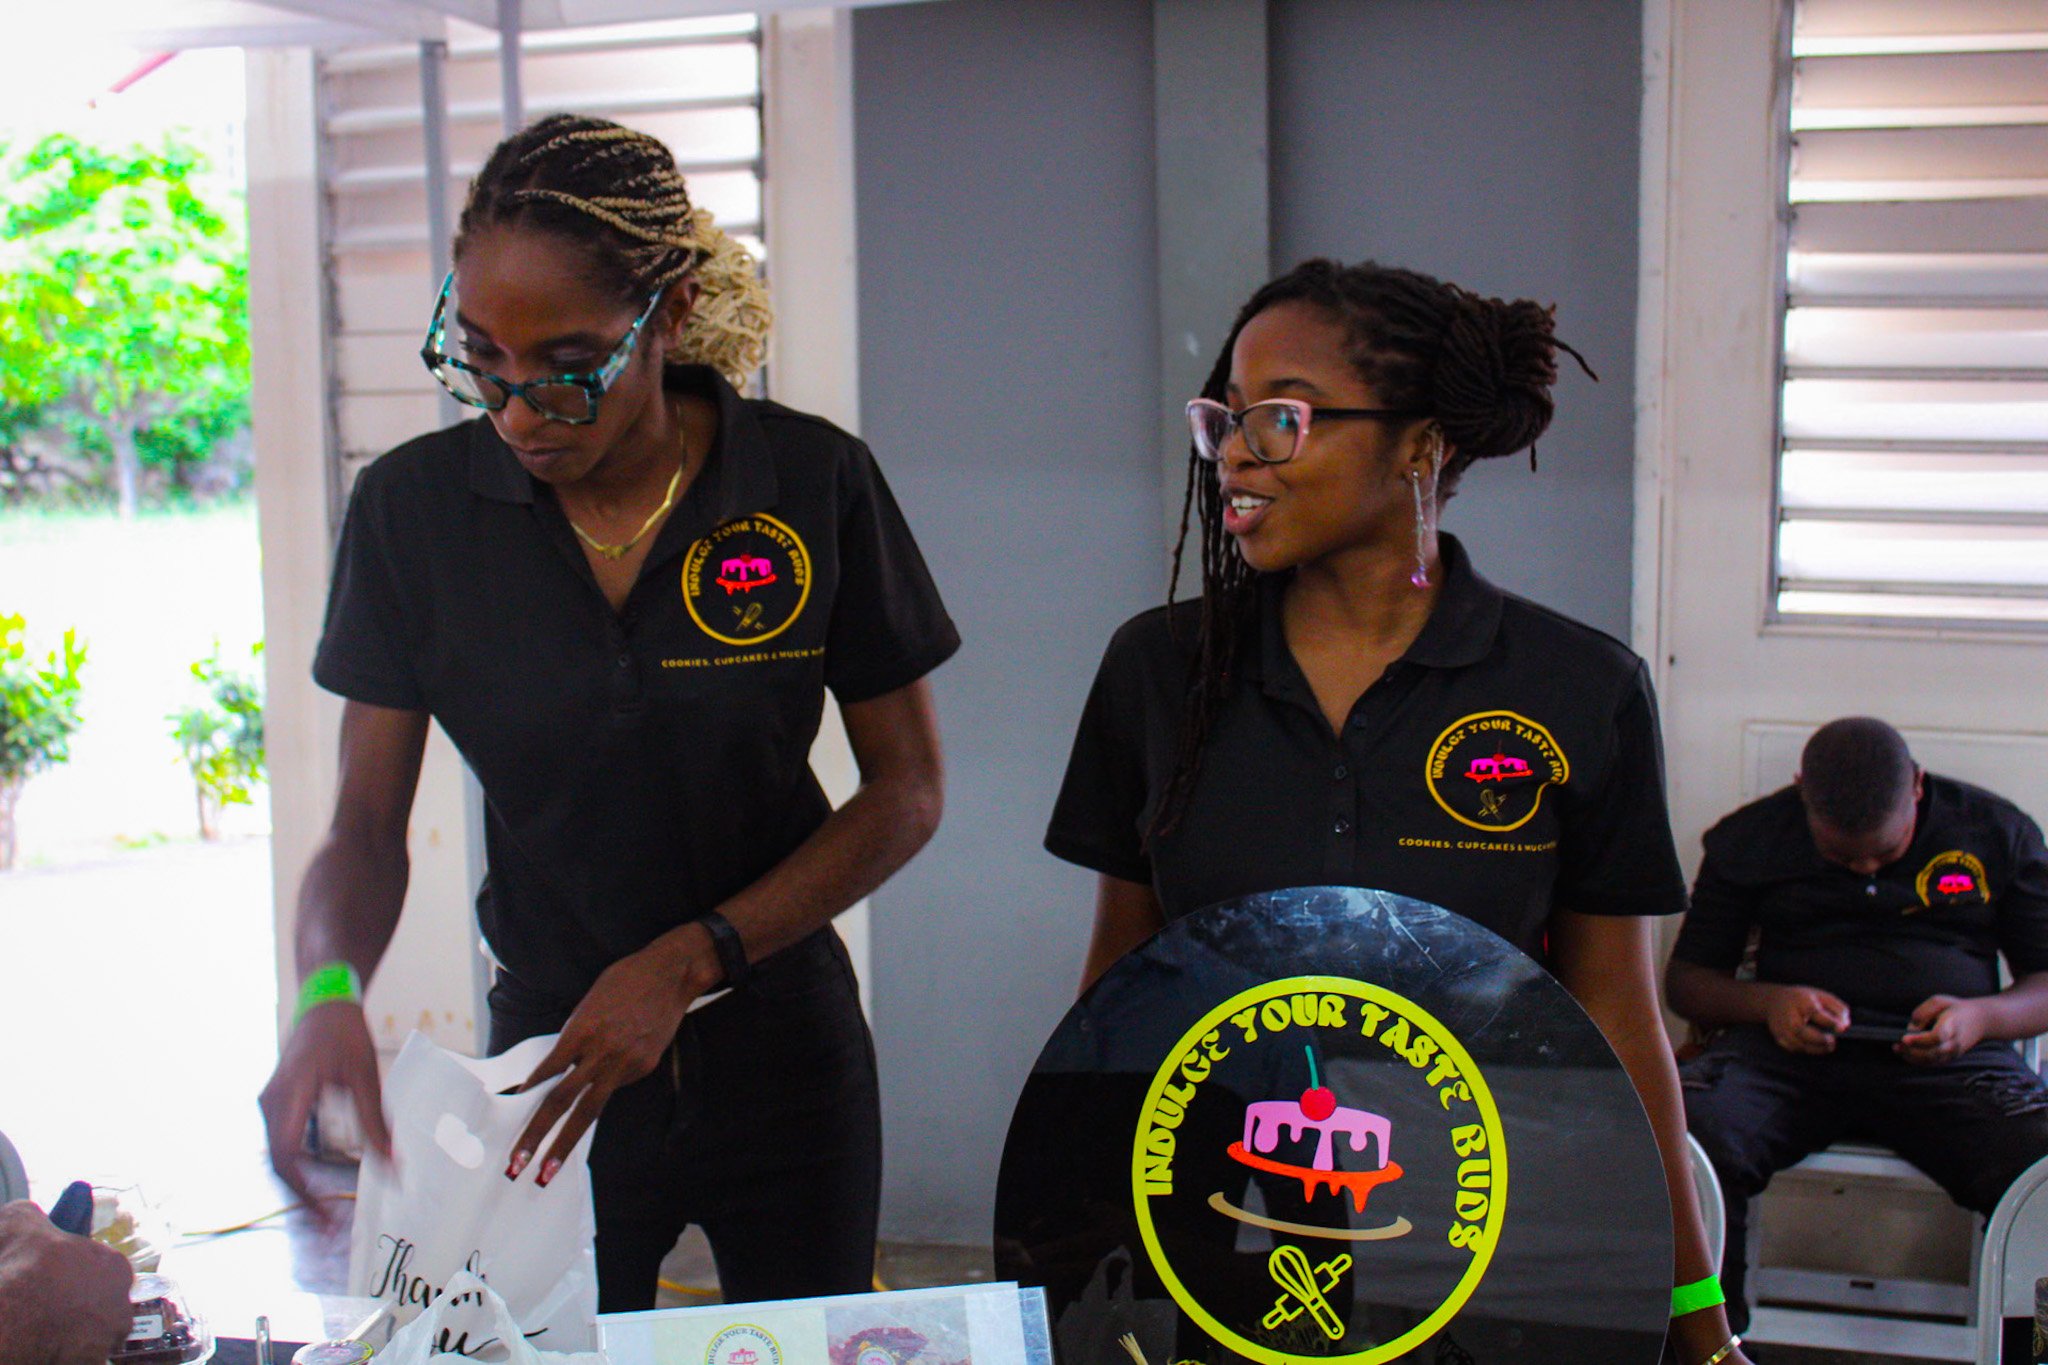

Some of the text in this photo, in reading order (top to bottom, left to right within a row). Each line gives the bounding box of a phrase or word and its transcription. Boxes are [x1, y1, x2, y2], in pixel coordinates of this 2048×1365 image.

[713, 520, 750, 543] YOUR
[754, 520, 794, 548] TASTE
[788, 549, 805, 586] BUDS
[714, 652, 769, 666] CUPCAKES
[779, 650, 808, 658] MUCH
[1432, 730, 1466, 779] INDULGE
[1468, 719, 1512, 733] YOUR
[1516, 724, 1555, 758] TASTE
[1456, 841, 1516, 852] CUPCAKES
[1144, 994, 1492, 1253] INDULGE YOUR TASTE BUDS
[723, 1327, 748, 1339] YOUR
[749, 1328, 773, 1347] TASTE
